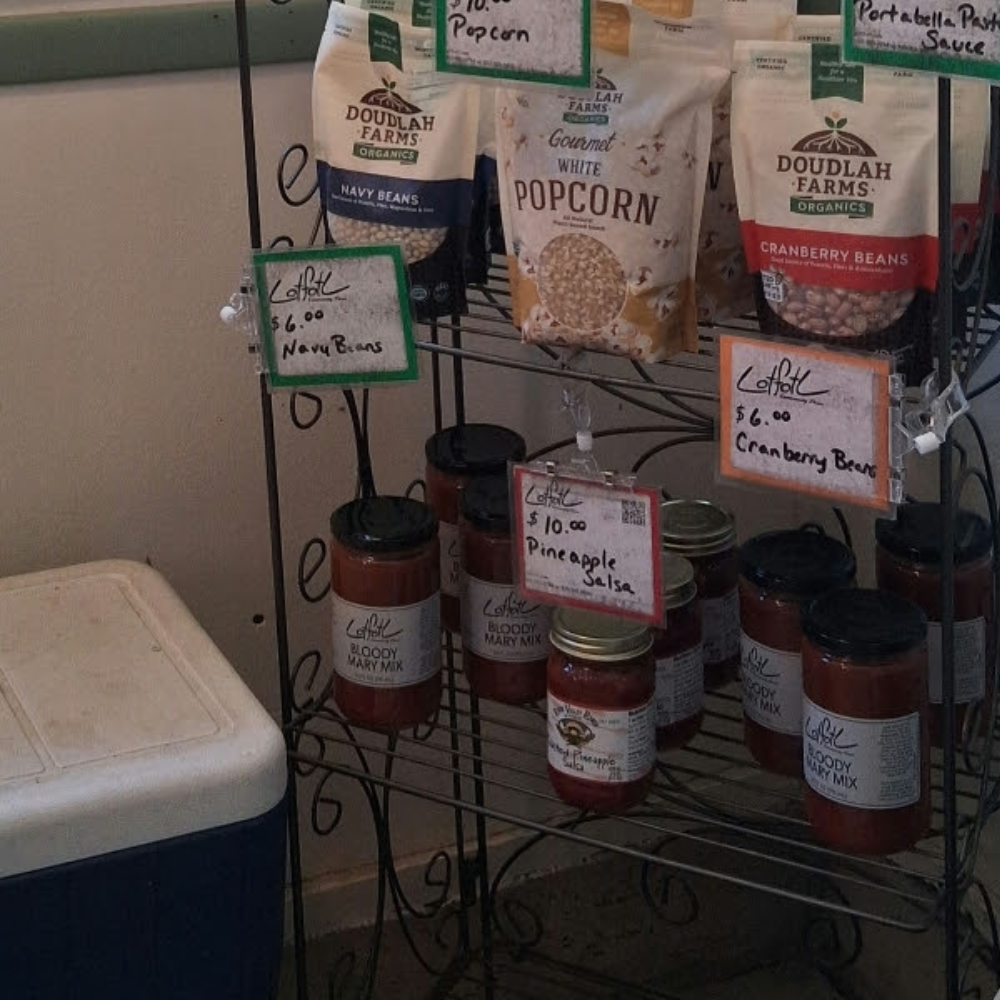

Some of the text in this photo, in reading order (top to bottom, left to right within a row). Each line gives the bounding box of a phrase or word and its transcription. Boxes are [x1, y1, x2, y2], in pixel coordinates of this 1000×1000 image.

[448, 13, 529, 43] Popcorn
[921, 30, 985, 55] Sauce
[569, 101, 609, 112] FARMS
[346, 105, 435, 131] DOUDLAH
[360, 126, 419, 147] FARMS
[549, 128, 617, 152] Gourmet
[359, 147, 415, 161] ORGANICS
[558, 158, 601, 177] WHITE
[777, 155, 892, 180] DOUDLAH
[341, 184, 374, 199] NAVY
[378, 190, 420, 206] BEANS
[797, 177, 869, 197] FARMS
[514, 179, 661, 226] POPCORN
[798, 202, 866, 213] ORGANICS
[760, 241, 850, 262] CRANBERRY
[854, 252, 908, 266] BEANS
[282, 335, 383, 360] Navy Bans
[735, 431, 827, 474] Cranberry
[526, 536, 616, 573] Pineapple
[583, 569, 636, 595] Salsa
[487, 621, 536, 635] BLOODY
[350, 642, 398, 659] BLOODY
[485, 633, 542, 647] MARY MIX
[347, 654, 403, 672] MARY MIX
[760, 699, 782, 717] MIX
[808, 743, 852, 773] BLOODY
[833, 772, 858, 790] MIX
